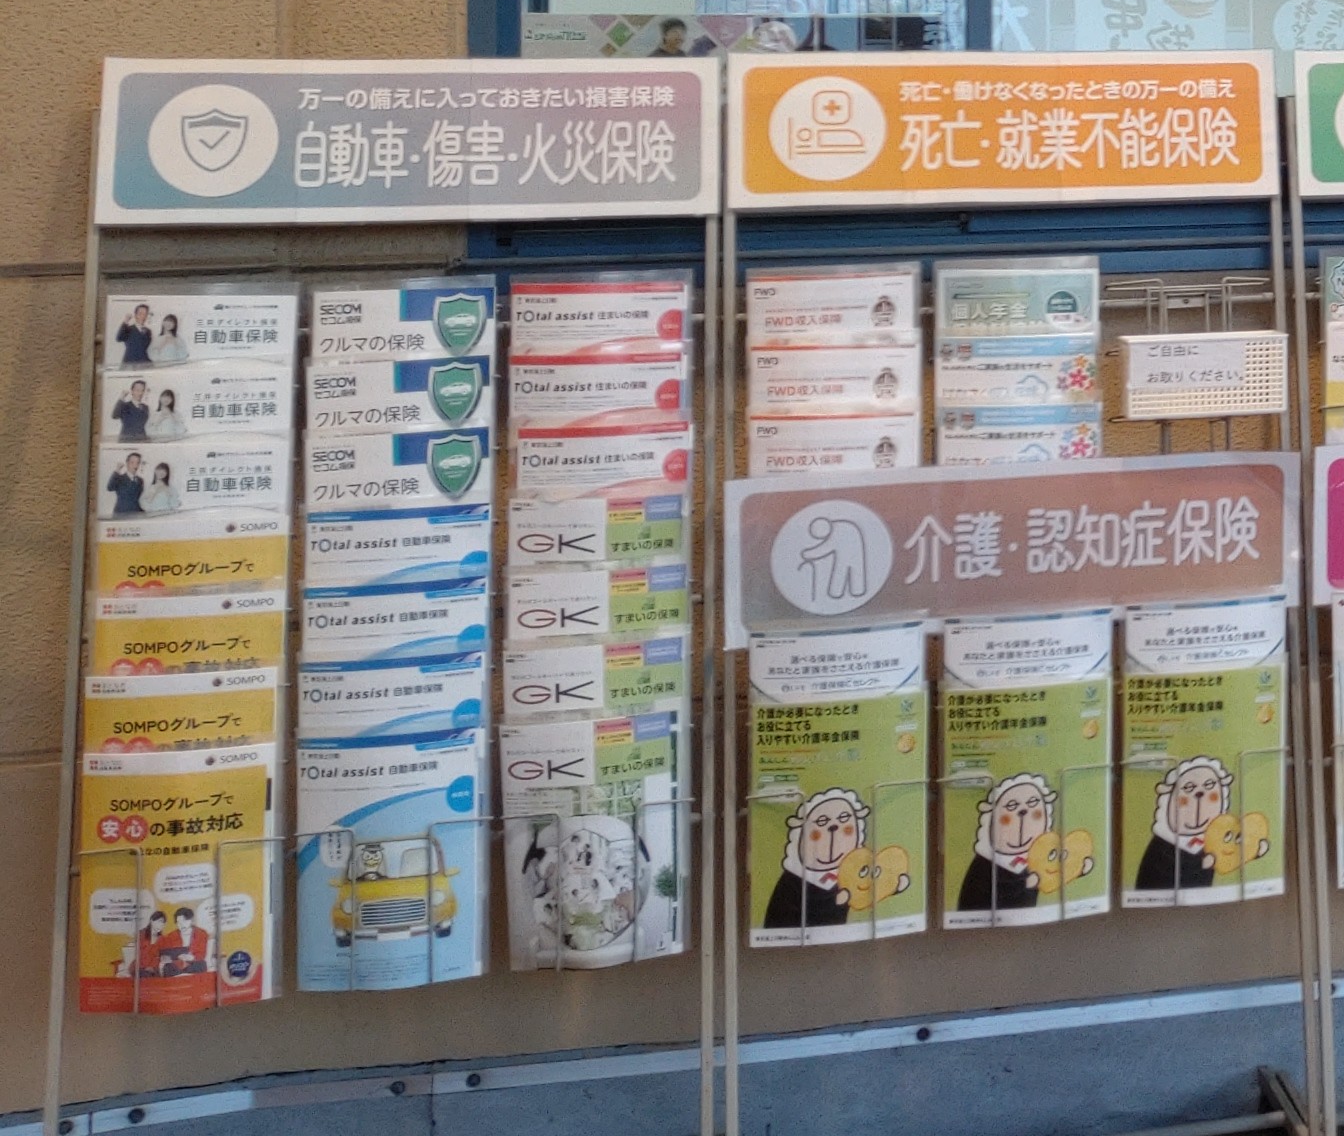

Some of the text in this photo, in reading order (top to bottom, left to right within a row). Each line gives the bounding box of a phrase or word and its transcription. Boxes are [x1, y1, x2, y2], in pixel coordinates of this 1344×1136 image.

[298, 86, 677, 110] 万一の備えに入っておきたい損害保険
[899, 78, 1238, 103] 死亡・働けなくなったときの万一の備え
[898, 106, 1241, 173] 死亡・就業不能保険
[293, 119, 678, 189] 自動車・傷害・火災保険
[319, 302, 363, 316] SECOM
[555, 310, 594, 321] assist
[952, 302, 1028, 321] 個人年金
[193, 329, 279, 345] 自動車保険
[319, 333, 426, 354] クルマの保険
[1148, 345, 1200, 358] ご自由に
[313, 376, 357, 389] SECOM
[1146, 369, 1245, 384] お取りください。
[553, 381, 593, 393] assist
[191, 401, 278, 420] 自動車保険
[313, 404, 421, 429] クルマの保険
[311, 449, 356, 462] SECOM
[561, 454, 602, 466] assist
[186, 475, 273, 493] 自動車保険
[312, 477, 420, 501] クルマの保険
[240, 521, 279, 533] SOMPO
[354, 537, 398, 549] assist
[517, 533, 675, 554] GK すまいの保険
[903, 495, 1261, 586] 介護・認知症保険
[236, 597, 275, 608] SOMPO
[351, 613, 395, 626] assist
[517, 605, 680, 629] GK すまいの保険
[226, 674, 266, 686] SOMPO
[1127, 675, 1224, 690] 介護が必要になったとき
[345, 687, 389, 701] assist
[512, 680, 676, 704] GK すまいの保険
[948, 691, 1047, 707] 介護が必要になったとき
[756, 703, 860, 720] 介護が必要になったとき
[219, 751, 258, 764] SOMPO
[507, 756, 666, 781] GK すまいの保険
[100, 812, 244, 839] 安心の事故対応
